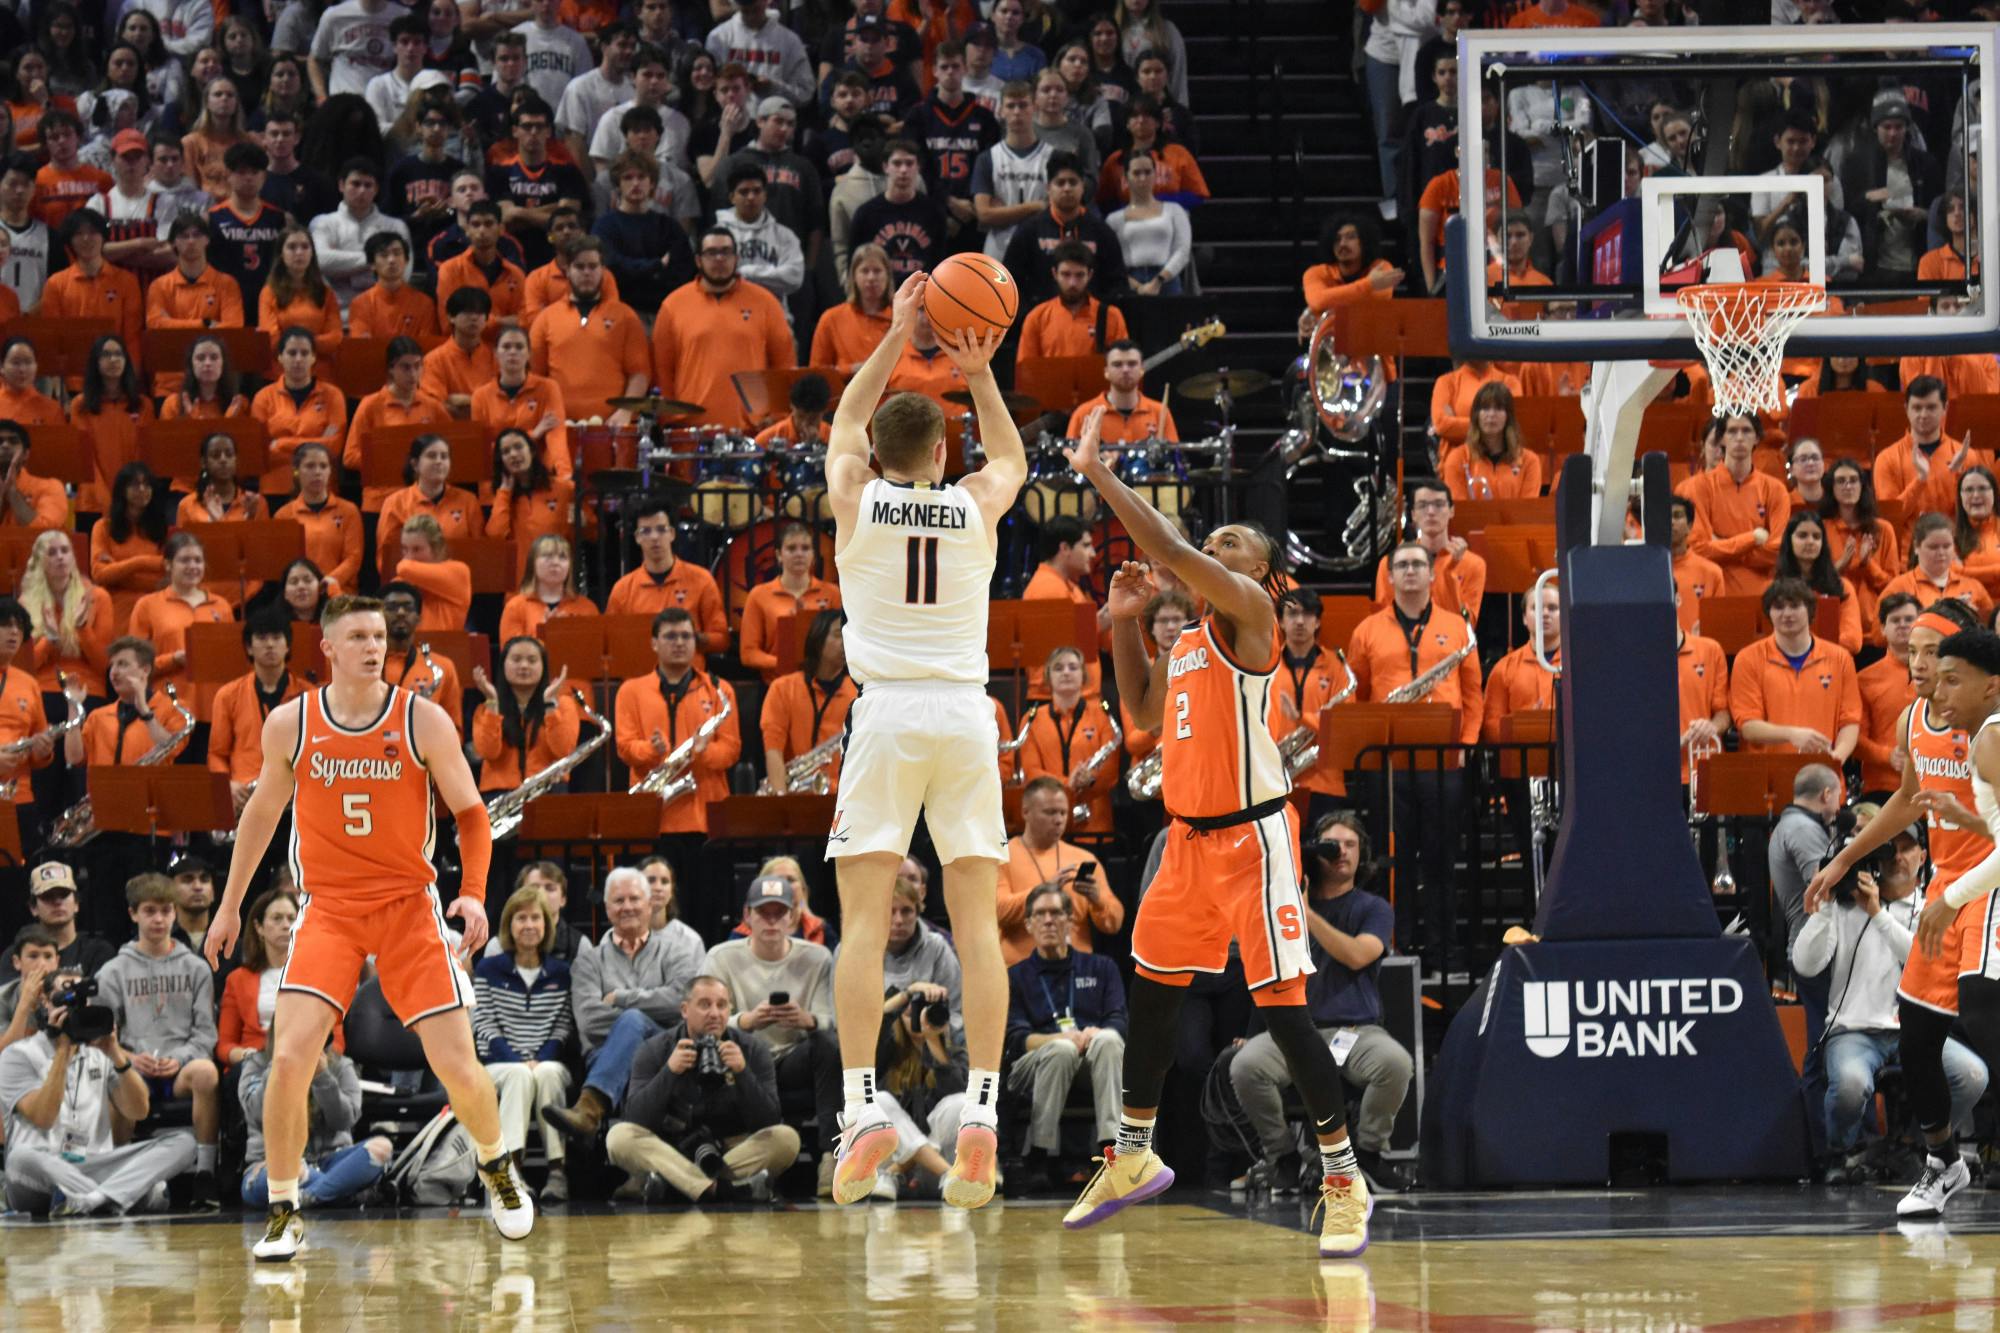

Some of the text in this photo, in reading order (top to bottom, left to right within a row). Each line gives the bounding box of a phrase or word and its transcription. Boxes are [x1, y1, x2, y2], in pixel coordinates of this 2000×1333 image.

[925, 137, 979, 151] VIRGINIA
[938, 152, 969, 179] 15
[221, 226, 279, 241] VIRGINIA
[243, 244, 260, 271] 5
[1488, 325, 1540, 337] SPALDING
[872, 501, 966, 529] McKNEELY
[905, 536, 938, 604] 11
[1176, 691, 1193, 740] 2
[309, 751, 402, 788] Syracuse
[1913, 747, 1970, 782] Syracuse
[342, 793, 373, 837] 5
[1276, 904, 1301, 941] S
[127, 974, 193, 997] VIRGINIA
[1575, 978, 1744, 1017] UNITED
[1576, 1020, 1699, 1058] BANK
